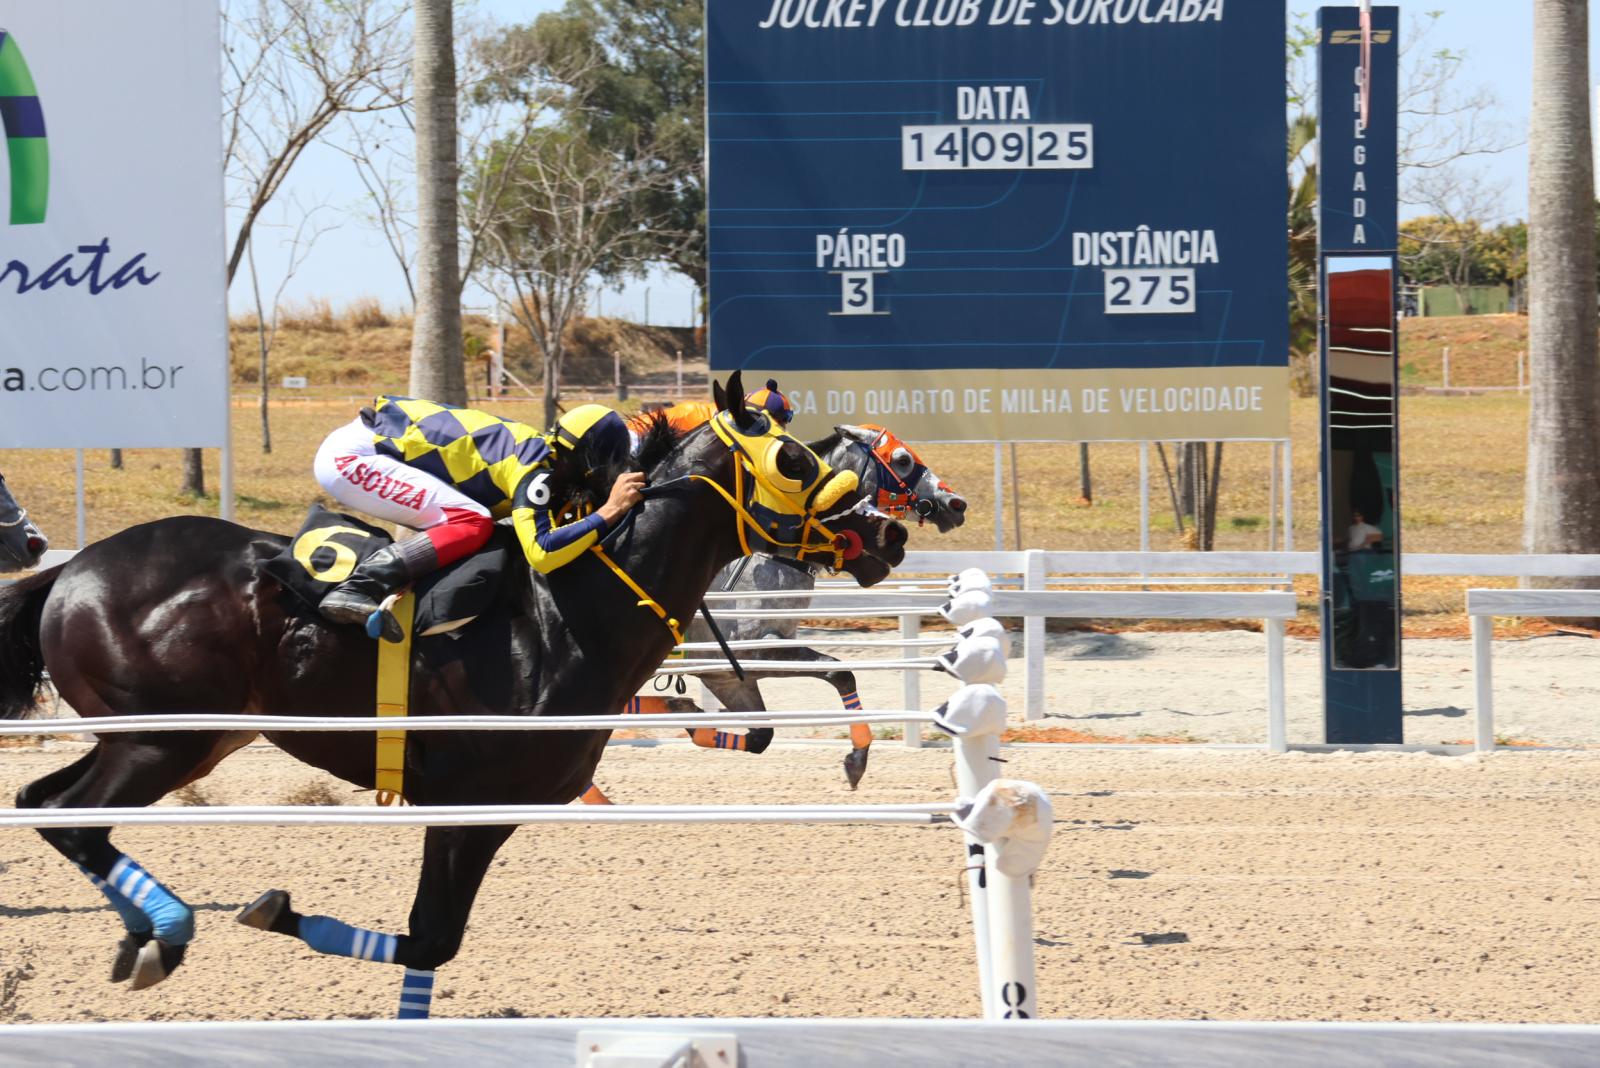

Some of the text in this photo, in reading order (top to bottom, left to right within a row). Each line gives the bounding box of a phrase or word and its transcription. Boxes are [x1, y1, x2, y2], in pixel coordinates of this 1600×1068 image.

[758, 0, 887, 29] JOCKEY
[894, 0, 983, 27] CLUB
[987, 0, 1032, 25] DE
[957, 86, 1031, 120] DATA
[816, 225, 1219, 268] PÁREO DISTÂNCIA
[847, 275, 1190, 308] 3 275
[0, 357, 184, 392] a.com.br
[827, 389, 856, 415] DO
[864, 388, 955, 415] QUARTO
[963, 388, 992, 414] DE
[1001, 388, 1073, 414] MILHA
[1081, 387, 1110, 414] DE
[1119, 385, 1263, 413] VELOCIDADE
[526, 472, 550, 505] 6
[293, 525, 370, 582] 6
